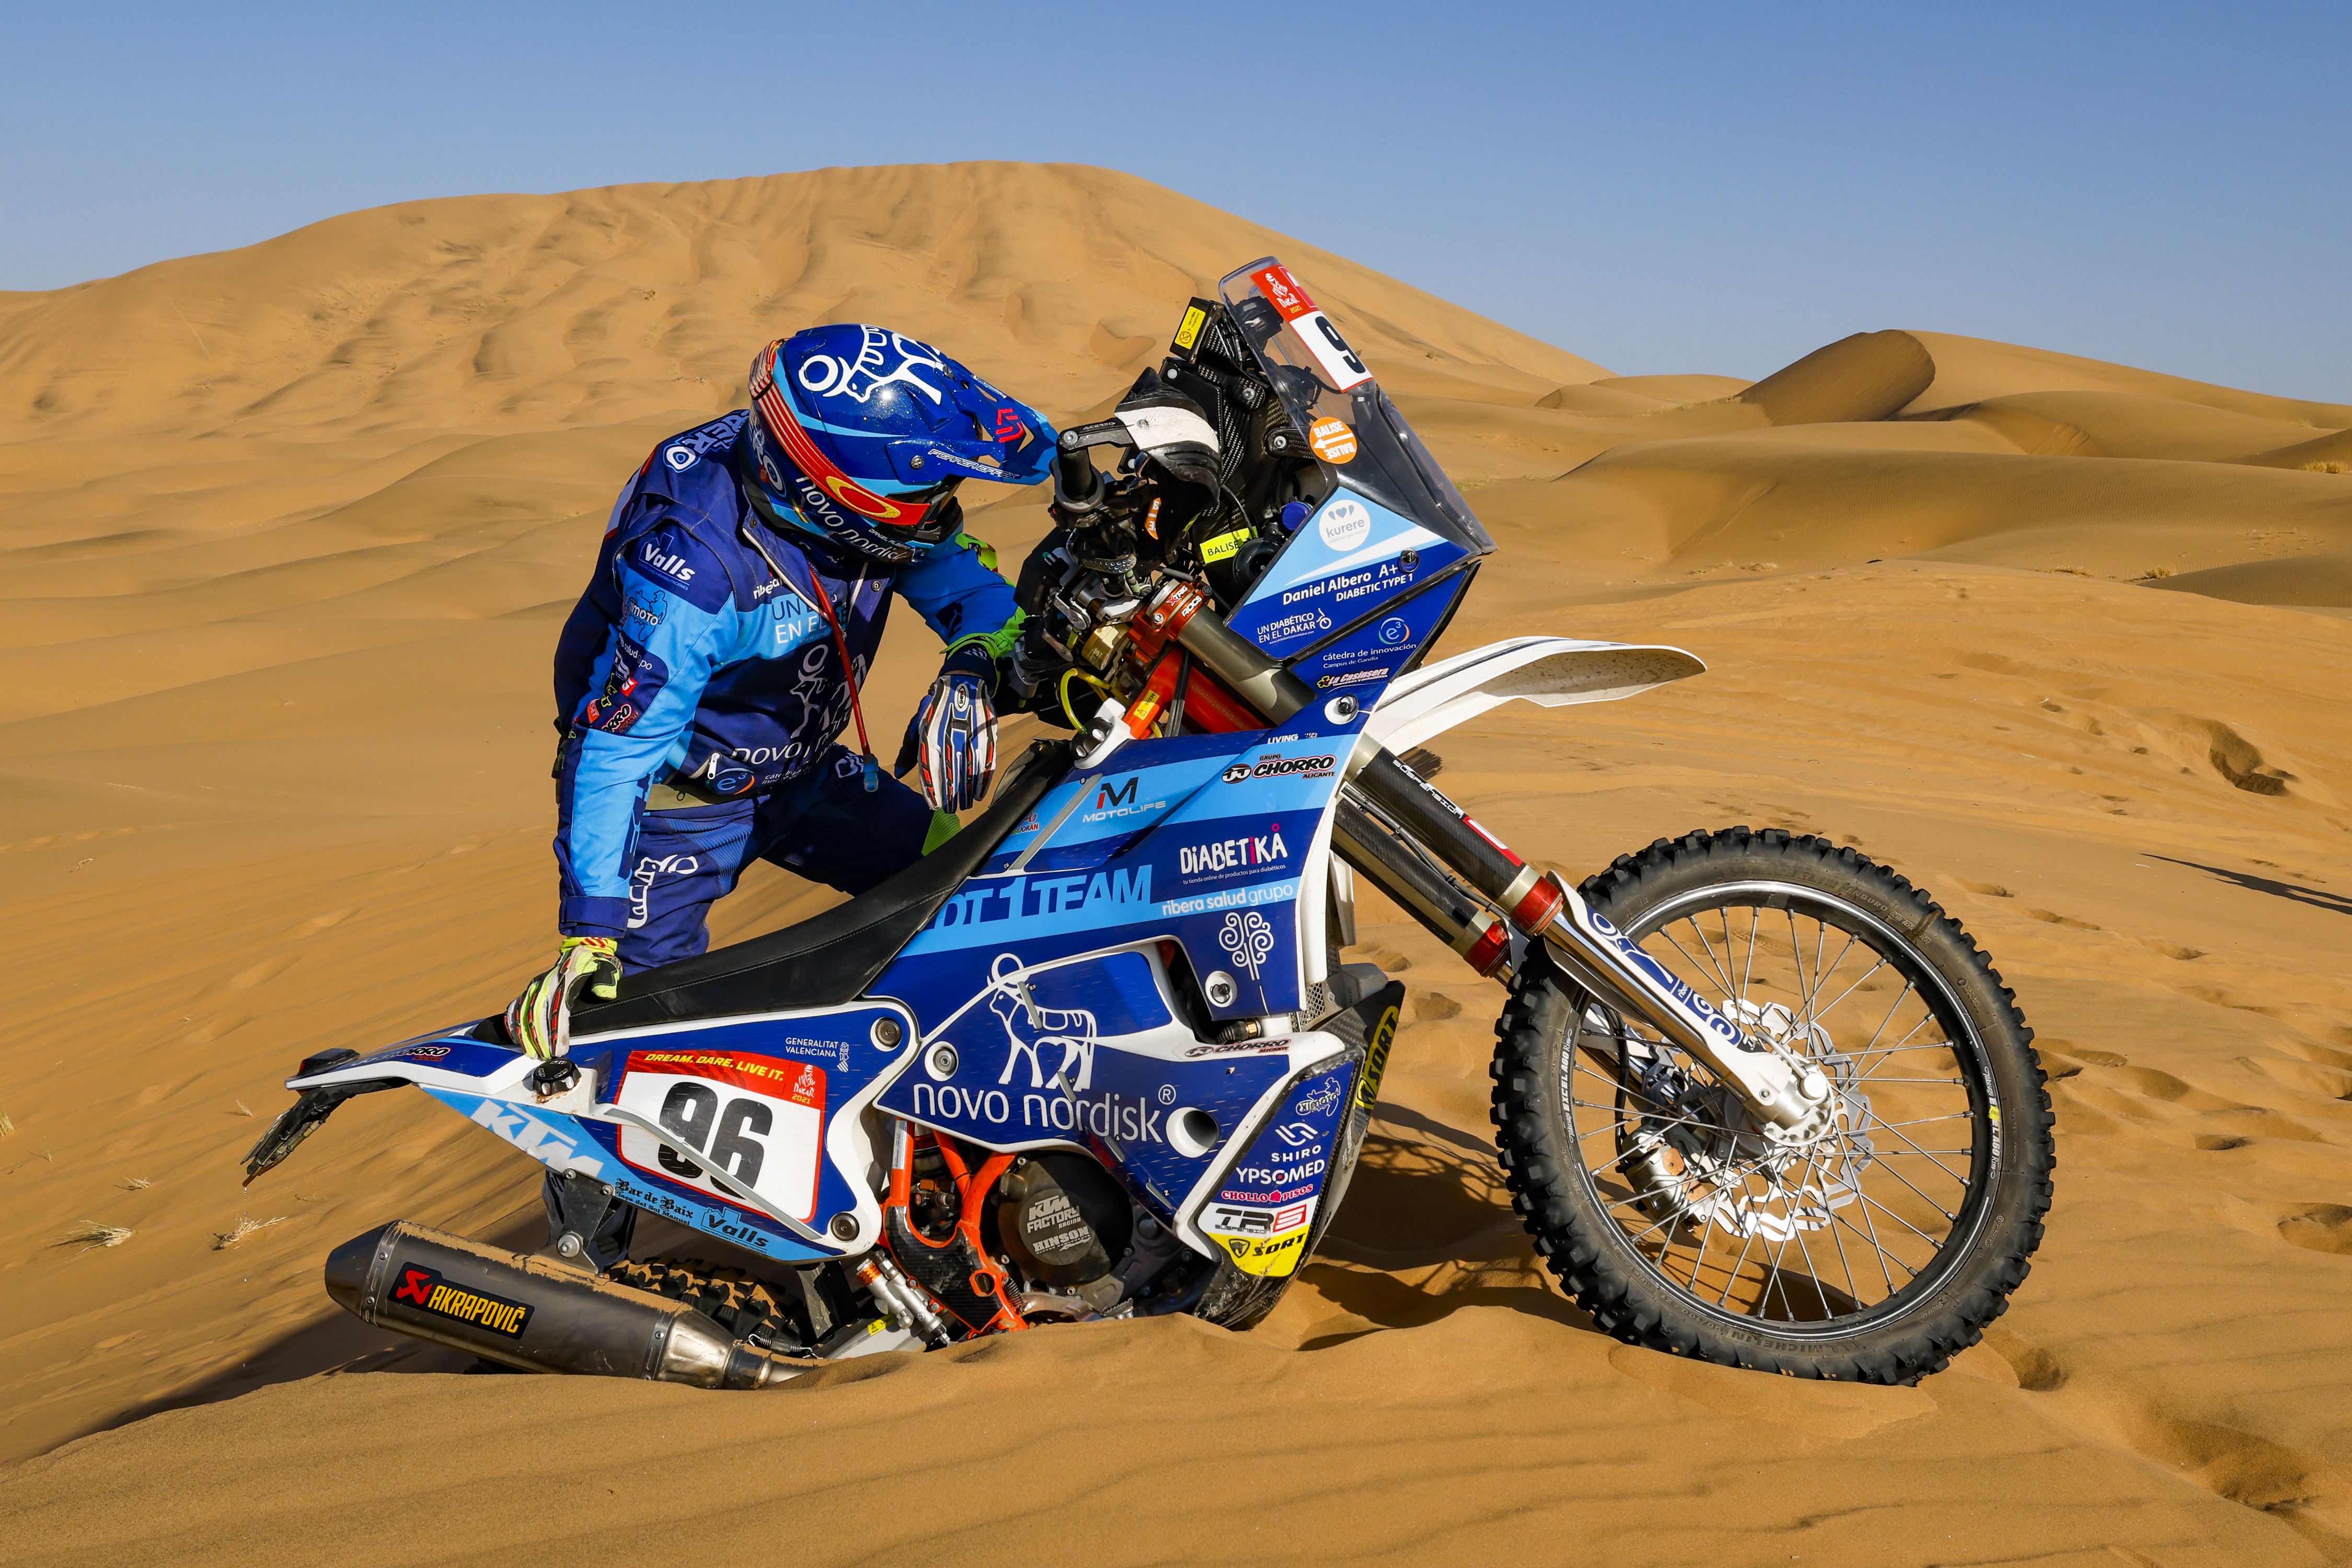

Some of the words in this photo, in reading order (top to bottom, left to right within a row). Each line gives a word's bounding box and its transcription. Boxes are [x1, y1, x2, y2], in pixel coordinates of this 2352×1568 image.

[1277, 293, 1300, 308] DAKAR
[1289, 305, 1302, 314] 2021
[1083, 421, 1116, 430] ACERBIS
[1313, 421, 1345, 438] BALISE
[1324, 442, 1355, 459] BALISE
[795, 476, 844, 527] novo
[869, 528, 888, 541] DANIEL
[1325, 519, 1365, 538] kurere
[1207, 540, 1239, 556] BALISE
[645, 543, 695, 580] Valls
[1283, 581, 1325, 605] Daniel
[1328, 572, 1371, 592] Albero
[1378, 564, 1398, 578] A+
[1336, 583, 1381, 602] DIABETIC
[1382, 574, 1406, 589] TYPE
[1409, 573, 1413, 582] 1
[772, 598, 801, 620] UN
[1181, 595, 1203, 618] ROCS
[776, 620, 802, 644] EN
[808, 615, 827, 633] EL
[1257, 624, 1270, 635] UN
[1270, 612, 1314, 630] DIABÉTICO
[1259, 632, 1270, 643] EN
[1272, 630, 1282, 640] EL
[1283, 621, 1316, 638] DAKAR
[1323, 651, 1355, 661] cátedra
[1370, 643, 1416, 655] innovación
[1267, 733, 1298, 744] LIVING
[731, 742, 802, 765] novo
[1253, 756, 1335, 777] CHORRO
[1082, 801, 1166, 823] MOTOLIFE
[1225, 871, 1249, 881] productos
[1260, 864, 1286, 872] diabéticos
[1031, 864, 1152, 914] TEAM
[1162, 898, 1204, 916] ribera
[1206, 889, 1247, 908] salud
[1248, 885, 1293, 906] grupo
[1846, 885, 1888, 913] ENDURO
[1888, 908, 1930, 946] MEDIM
[786, 1037, 838, 1049] GENERALITAT
[786, 1046, 837, 1058] VALENCIANA
[1368, 1012, 1398, 1086] SORT
[644, 1053, 694, 1063] DREAM.
[695, 1056, 733, 1068] DARE.
[736, 1061, 768, 1076] LIVE
[769, 1069, 784, 1082] IT.
[1561, 1051, 1570, 1072] A60
[792, 1094, 811, 1104] 2021
[793, 1083, 815, 1098] DAKAR
[1561, 1072, 1571, 1111] EXCEL
[914, 1083, 1009, 1123] novo
[471, 1099, 604, 1177] KTM
[658, 1081, 773, 1200] 96
[1987, 1133, 2003, 1156] A60
[1271, 1145, 1321, 1162] SHIRO
[1236, 1159, 1325, 1185] YPSOMED
[615, 1178, 641, 1197] Bar
[643, 1192, 658, 1204] de
[660, 1196, 694, 1219] Baix
[1221, 1191, 1269, 1202] CHOLLO
[1282, 1184, 1313, 1201] PISOS
[635, 1198, 647, 1207] del
[648, 1204, 661, 1213] Sol
[662, 1210, 690, 1225] Manuel
[1027, 1205, 1080, 1233] FACTORY
[1029, 1195, 1070, 1221] KTM
[700, 1227, 732, 1242] CONSTRUCCIONES
[709, 1214, 769, 1248] Valls
[1033, 1226, 1089, 1252] HINSON
[1253, 1233, 1305, 1256] SORT
[1730, 1330, 1824, 1353] MICHELIN
